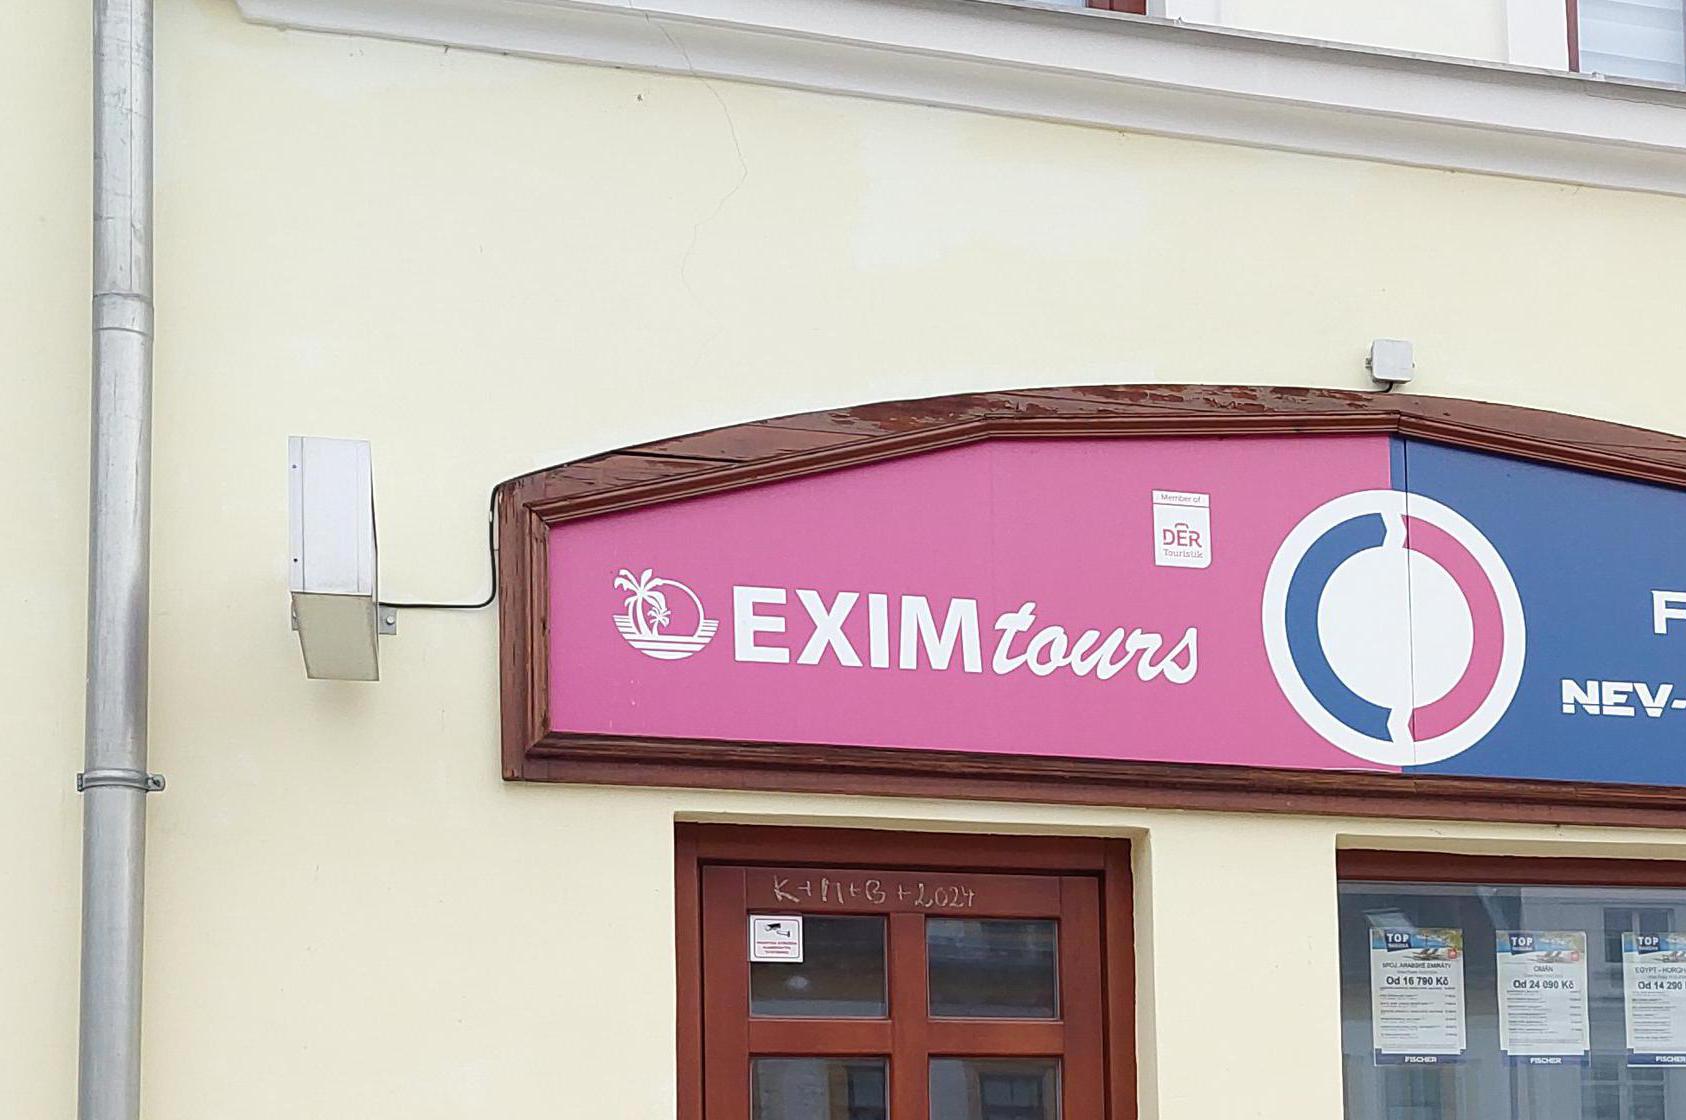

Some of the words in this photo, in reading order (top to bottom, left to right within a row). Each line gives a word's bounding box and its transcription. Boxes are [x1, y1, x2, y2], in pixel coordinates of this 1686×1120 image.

[1163, 548, 1203, 558] Touristik
[1386, 933, 1409, 942] TOP
[1510, 937, 1533, 946] TOP
[1638, 936, 1659, 946] TOP
[1386, 976, 1400, 985] Od
[1416, 976, 1433, 985] 790
[1436, 976, 1449, 986] Kč
[1513, 979, 1526, 989] Od
[1529, 980, 1540, 988] 24
[1561, 980, 1574, 989] Kč
[1638, 981, 1651, 990] Od
[1654, 981, 1665, 990] 14
[1666, 981, 1682, 990] 290
